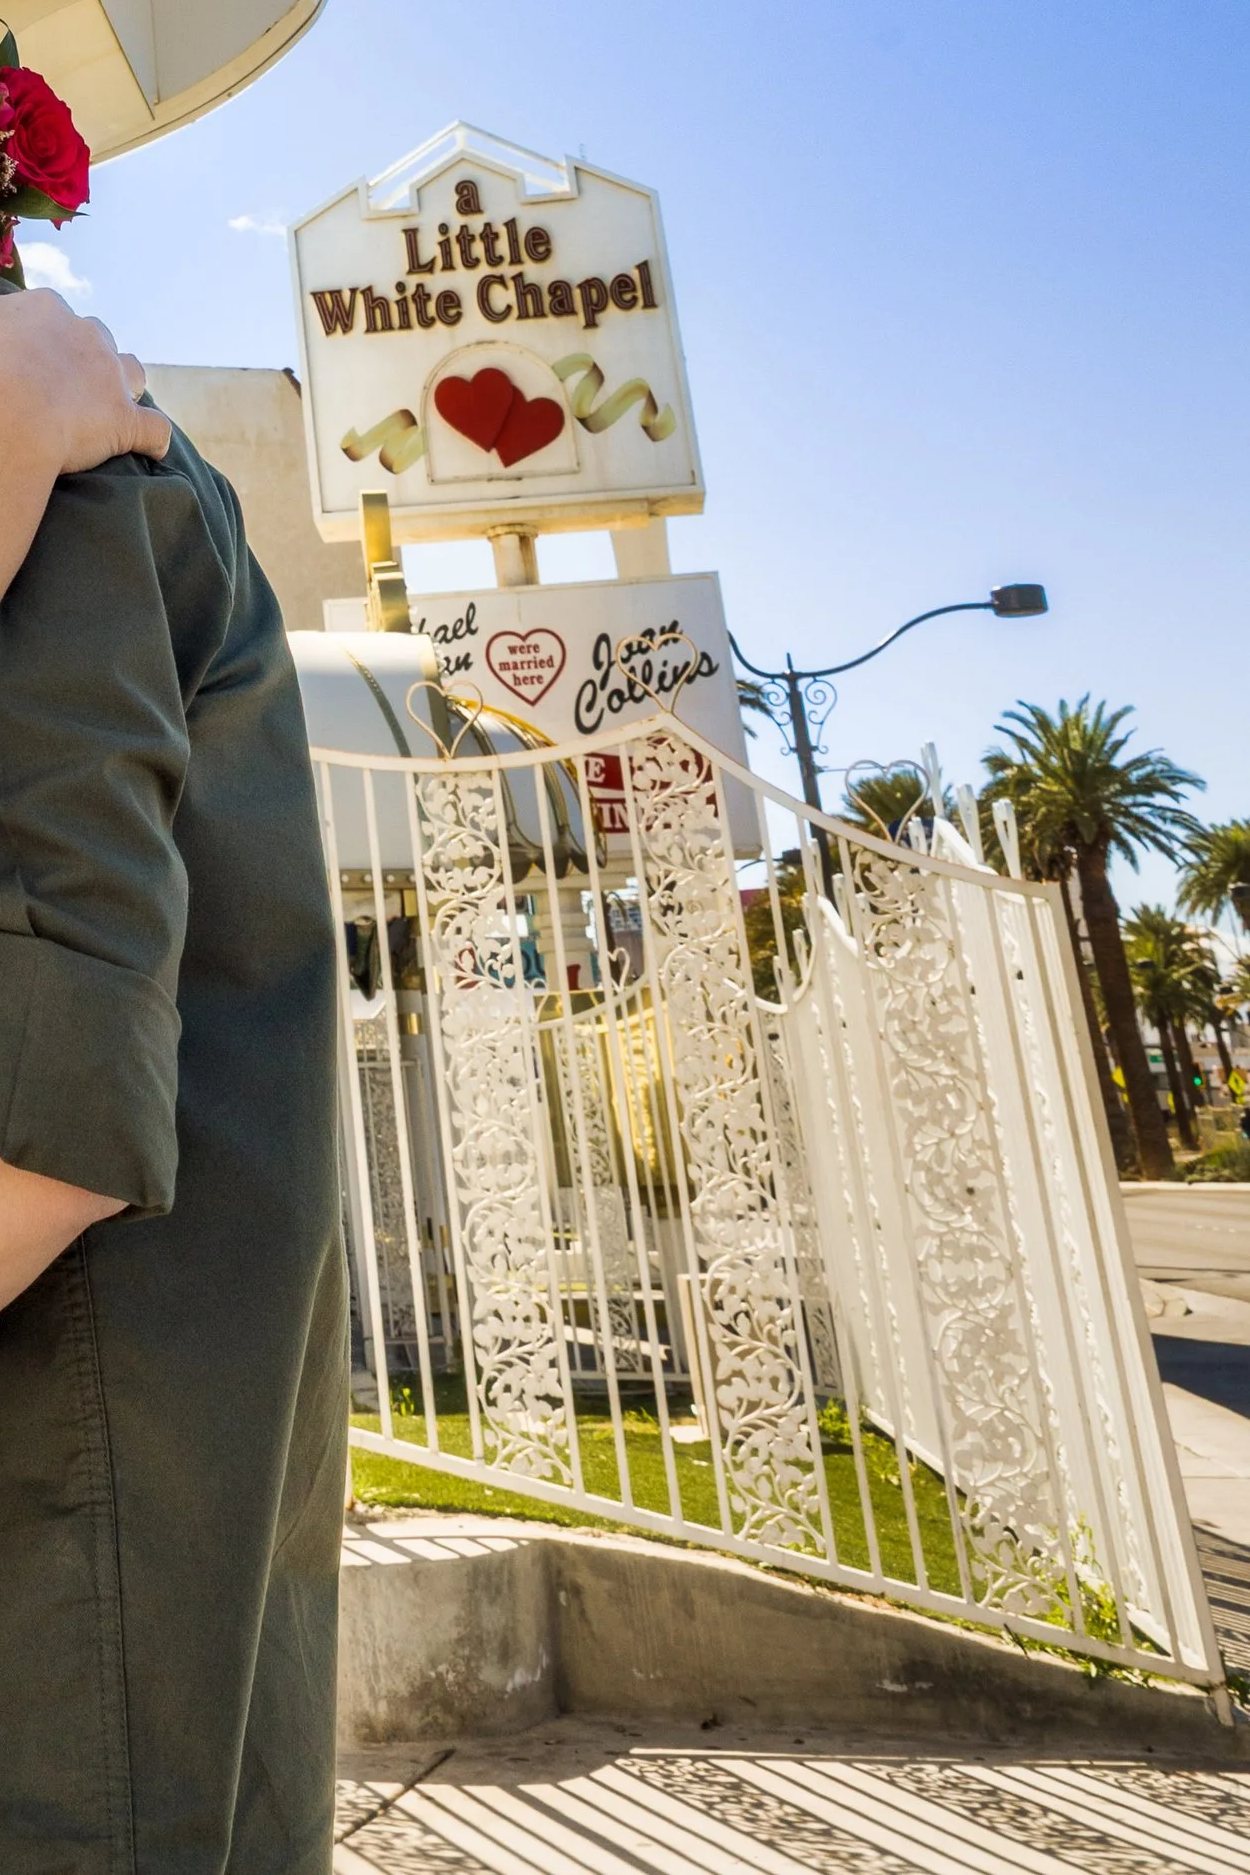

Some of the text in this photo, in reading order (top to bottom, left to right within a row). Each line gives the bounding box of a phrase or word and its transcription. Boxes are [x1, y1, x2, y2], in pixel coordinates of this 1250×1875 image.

[454, 179, 483, 216] a
[401, 216, 553, 276] Little
[310, 259, 659, 337] White Chapel
[498, 654, 555, 671] married
[507, 643, 540, 655] were
[512, 672, 544, 686] here
[574, 651, 720, 735] Collins
